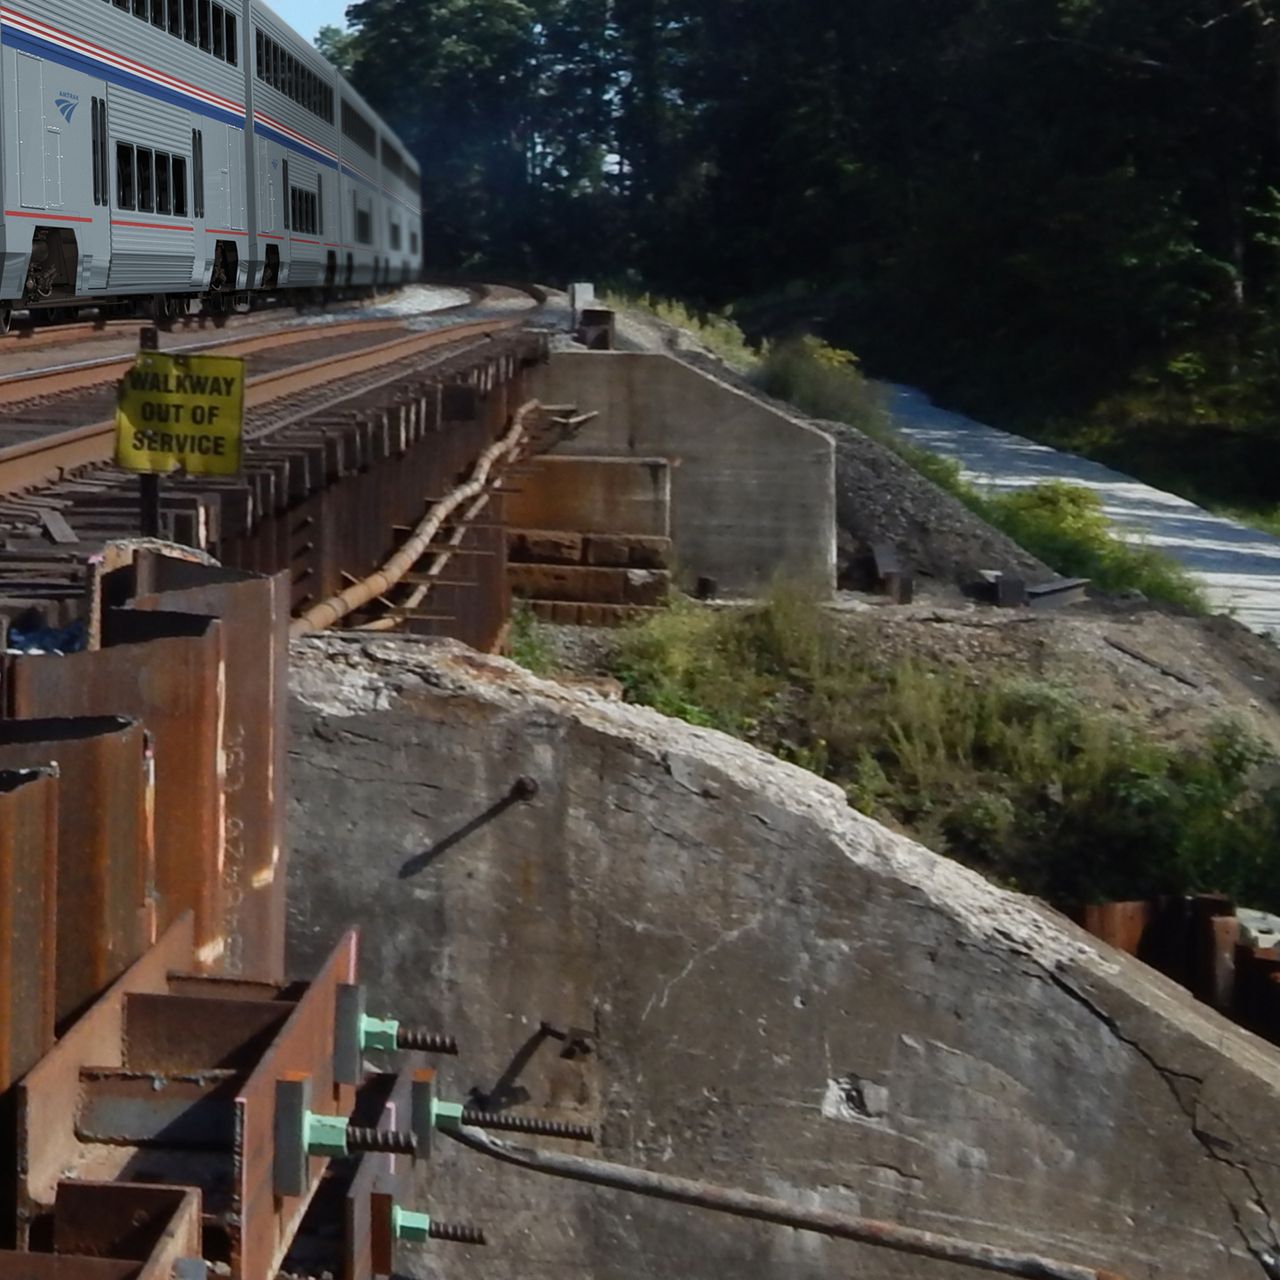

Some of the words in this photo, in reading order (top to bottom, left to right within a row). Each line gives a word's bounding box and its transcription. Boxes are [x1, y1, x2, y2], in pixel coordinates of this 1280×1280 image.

[130, 372, 235, 397] WALKWAY
[142, 404, 184, 424] OUT
[192, 405, 220, 425] OF
[133, 431, 226, 456] SERVICE
